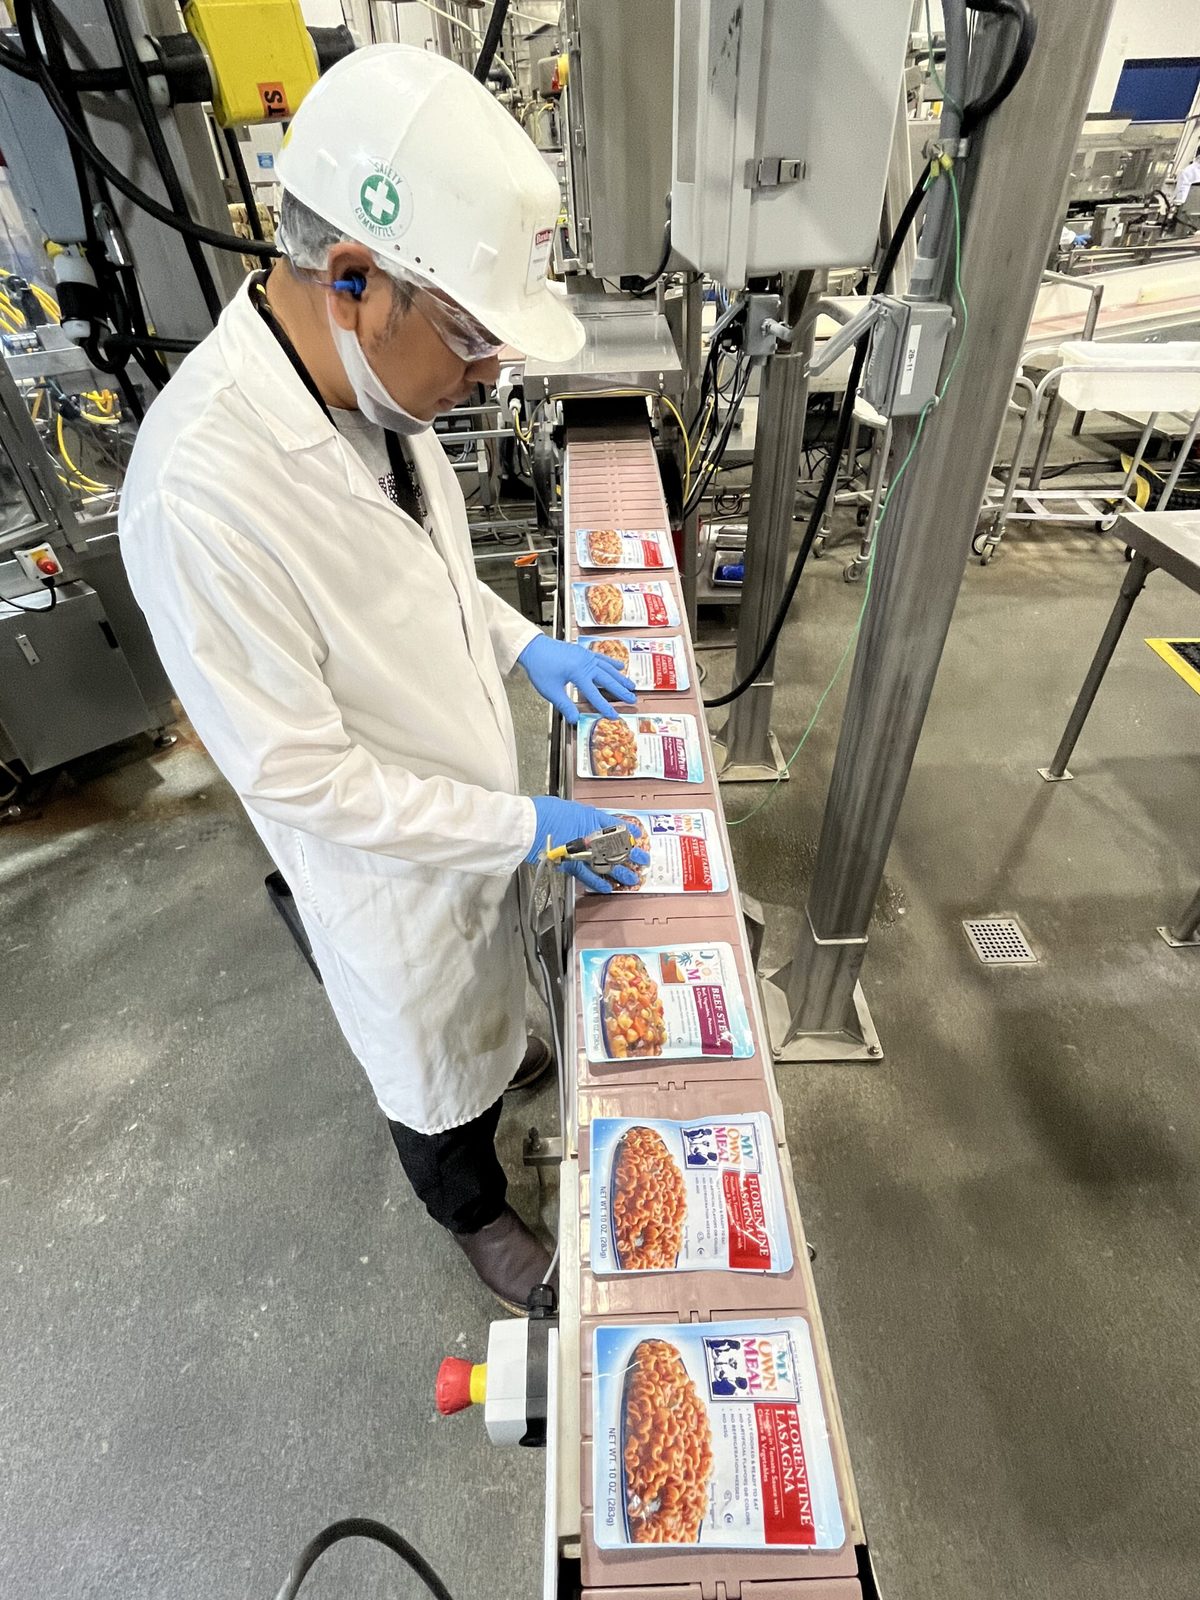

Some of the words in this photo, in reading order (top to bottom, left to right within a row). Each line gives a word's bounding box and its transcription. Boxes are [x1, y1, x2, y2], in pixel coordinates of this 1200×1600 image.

[699, 951, 715, 959] J
[685, 968, 701, 980] M
[710, 987, 722, 1011] BEEF
[726, 1128, 741, 1164] OWN
[740, 1135, 753, 1158] MY
[748, 1177, 769, 1256] FLORENTINE
[741, 1338, 762, 1394] MEAL
[757, 1340, 777, 1391] OWN
[774, 1350, 791, 1383] MY
[729, 1413, 735, 1423] NO
[730, 1424, 739, 1473] REFRIGERATION
[738, 1413, 744, 1422] NO
[743, 1487, 749, 1496] OR
[759, 1442, 770, 1482] Vegetables
[768, 1446, 776, 1473] Tomato
[774, 1409, 795, 1493] LASAGNA
[608, 1468, 616, 1478] 10
[786, 1409, 812, 1526] FLORENTINE
[608, 1481, 616, 1495] OZ.
[752, 1487, 758, 1497] TO
[770, 1475, 778, 1497] Sauce
[606, 1498, 616, 1526] (283g)
[772, 1498, 780, 1515] with
